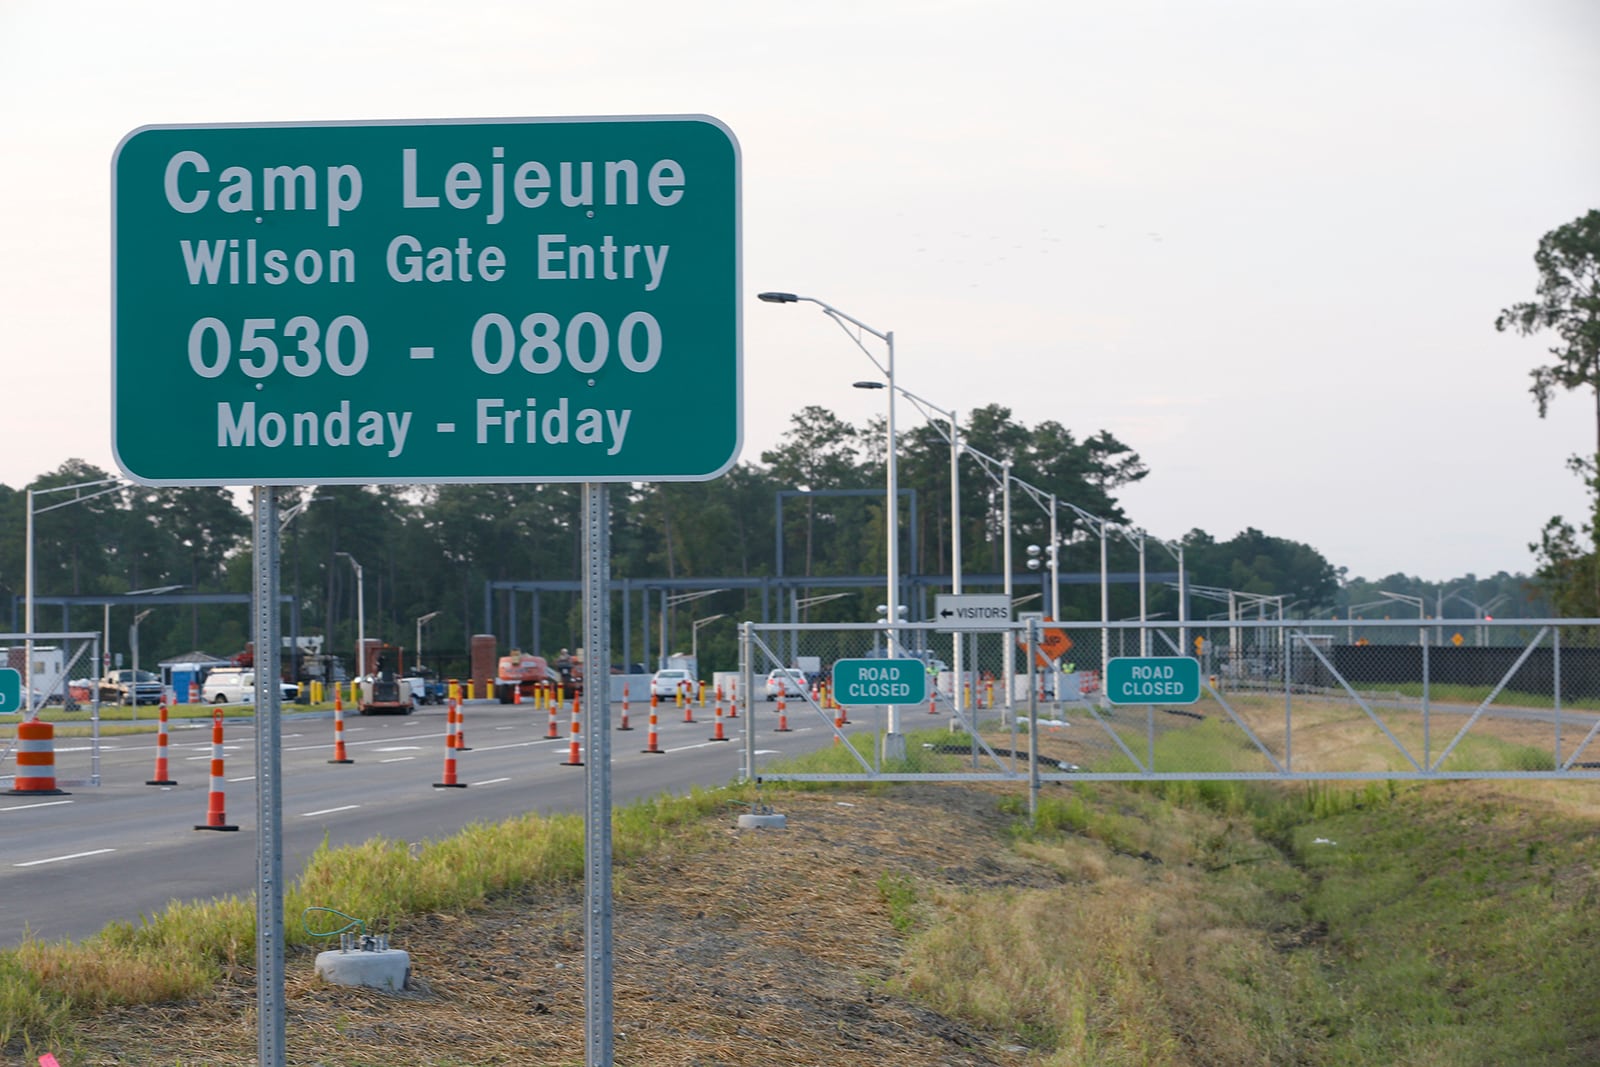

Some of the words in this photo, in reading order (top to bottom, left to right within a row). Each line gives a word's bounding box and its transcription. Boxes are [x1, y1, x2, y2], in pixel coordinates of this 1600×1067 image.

[164, 150, 363, 227] Camp
[403, 146, 686, 225] Lejeune
[179, 238, 355, 285] Wilson
[386, 234, 506, 283] Gate
[537, 233, 670, 292] Entry
[188, 315, 369, 379] 0530
[410, 346, 435, 360] -
[471, 311, 663, 375] 0800
[217, 400, 413, 458] Monday
[436, 422, 455, 433] -
[476, 397, 632, 456] Friday
[956, 607, 1008, 619] VISITORS
[858, 667, 901, 681] ROAD
[1132, 665, 1174, 680] ROAD
[849, 683, 910, 697] CLOSED
[1122, 682, 1184, 696] CLOSED
